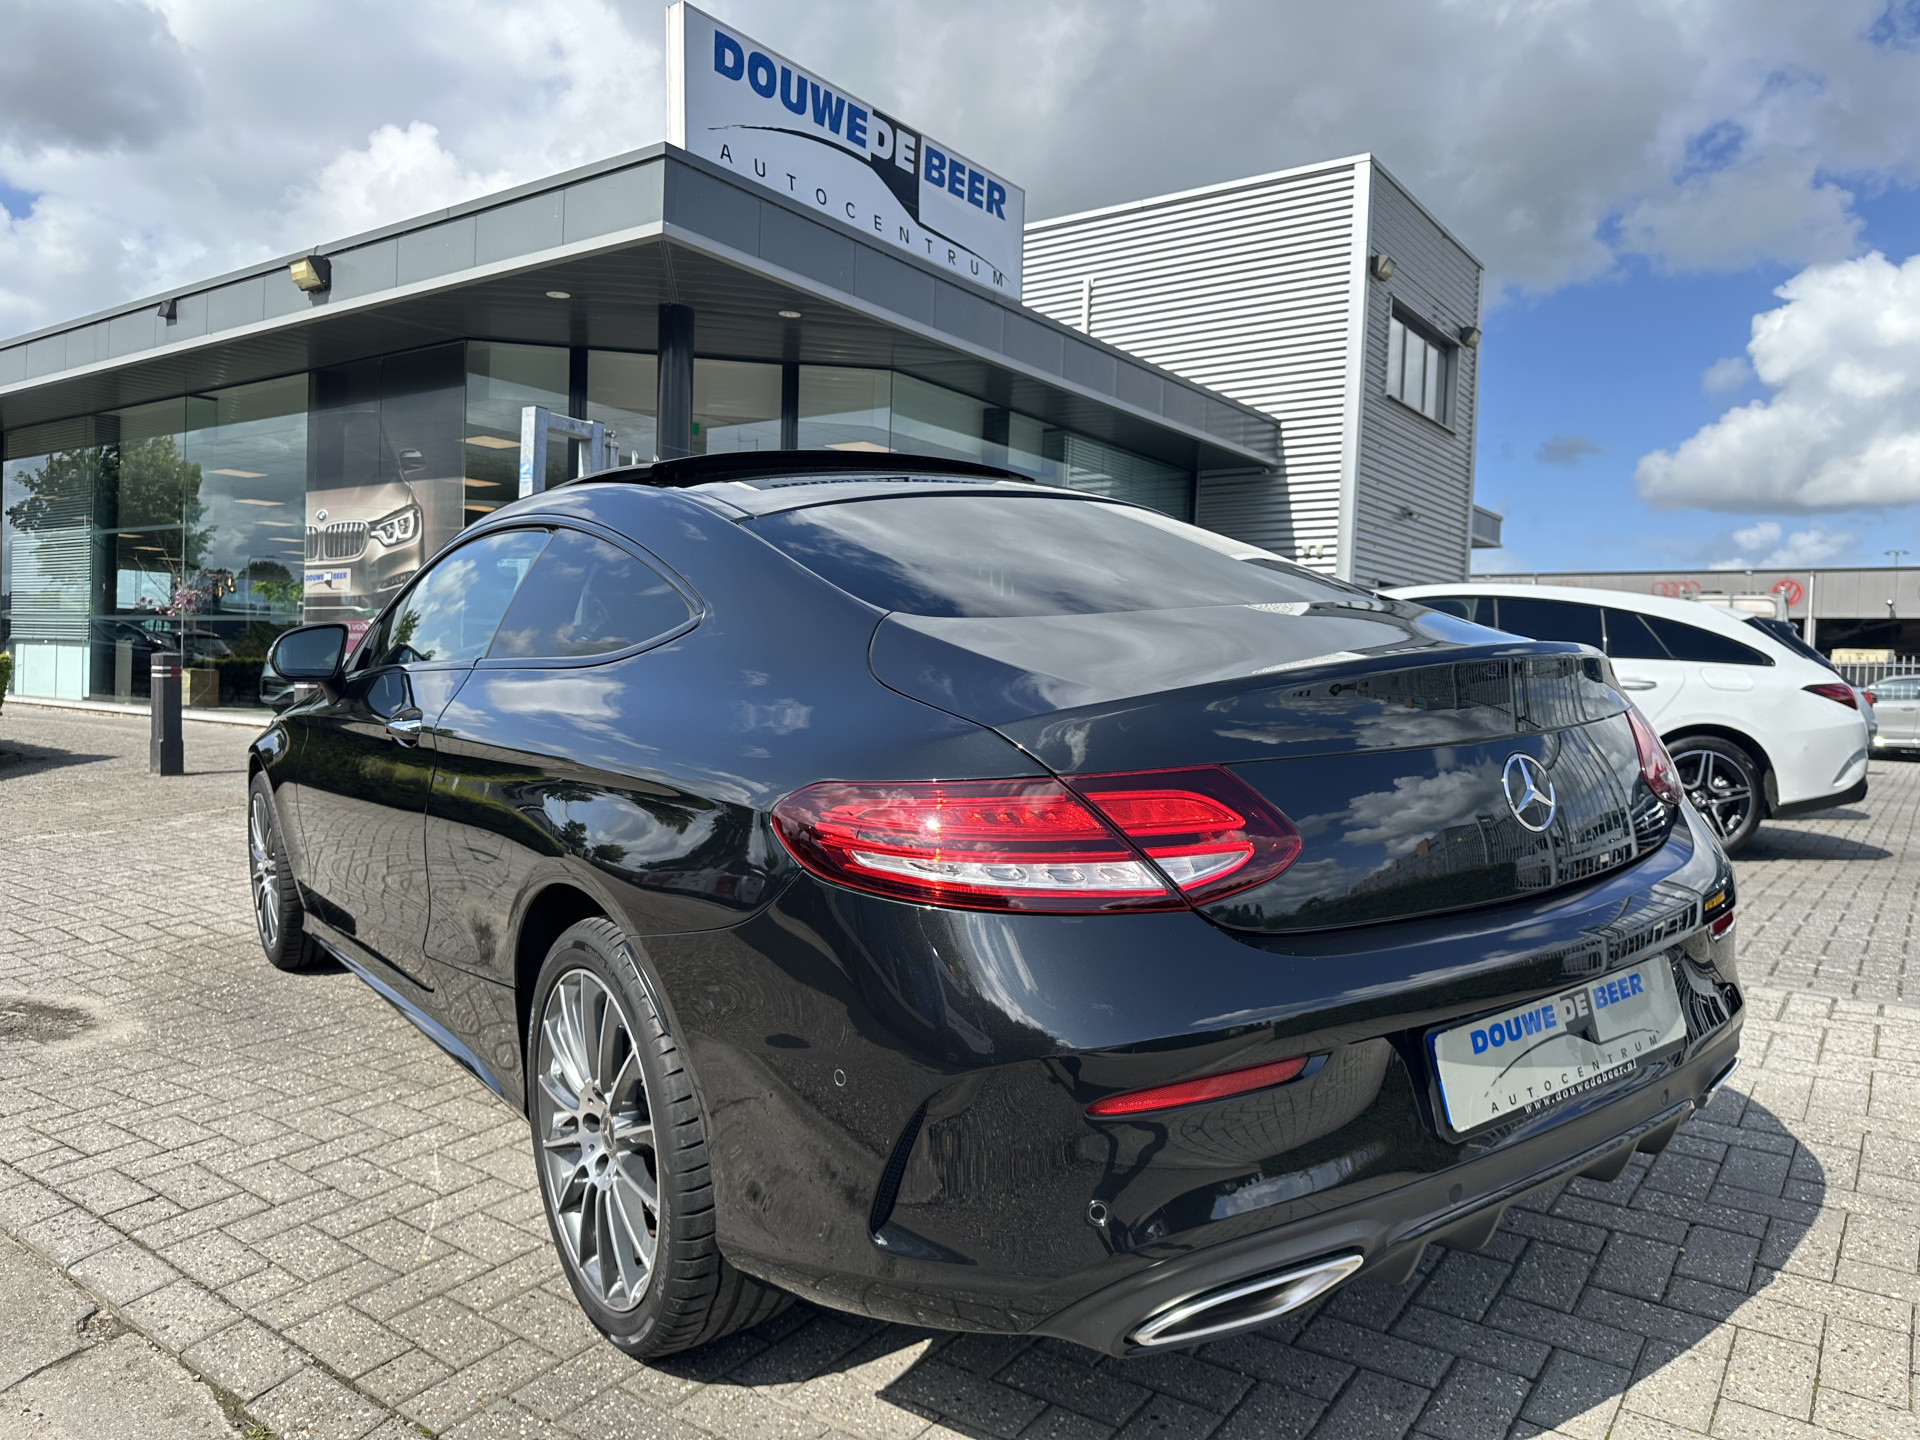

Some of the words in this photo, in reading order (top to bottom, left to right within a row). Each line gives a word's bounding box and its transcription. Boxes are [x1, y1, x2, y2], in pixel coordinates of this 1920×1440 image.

[714, 29, 868, 149] DOUWE
[868, 115, 917, 175] DE
[924, 144, 1006, 221] BEER
[720, 144, 1003, 287] AUTOCENTRUM
[1470, 1005, 1556, 1055] DOUWE
[1560, 992, 1588, 1024] DE
[1592, 972, 1643, 1010] BEER
[1492, 1035, 1657, 1113] AUTOCENTRUM
[1523, 1058, 1637, 1114] www.douwedebeer.nl
